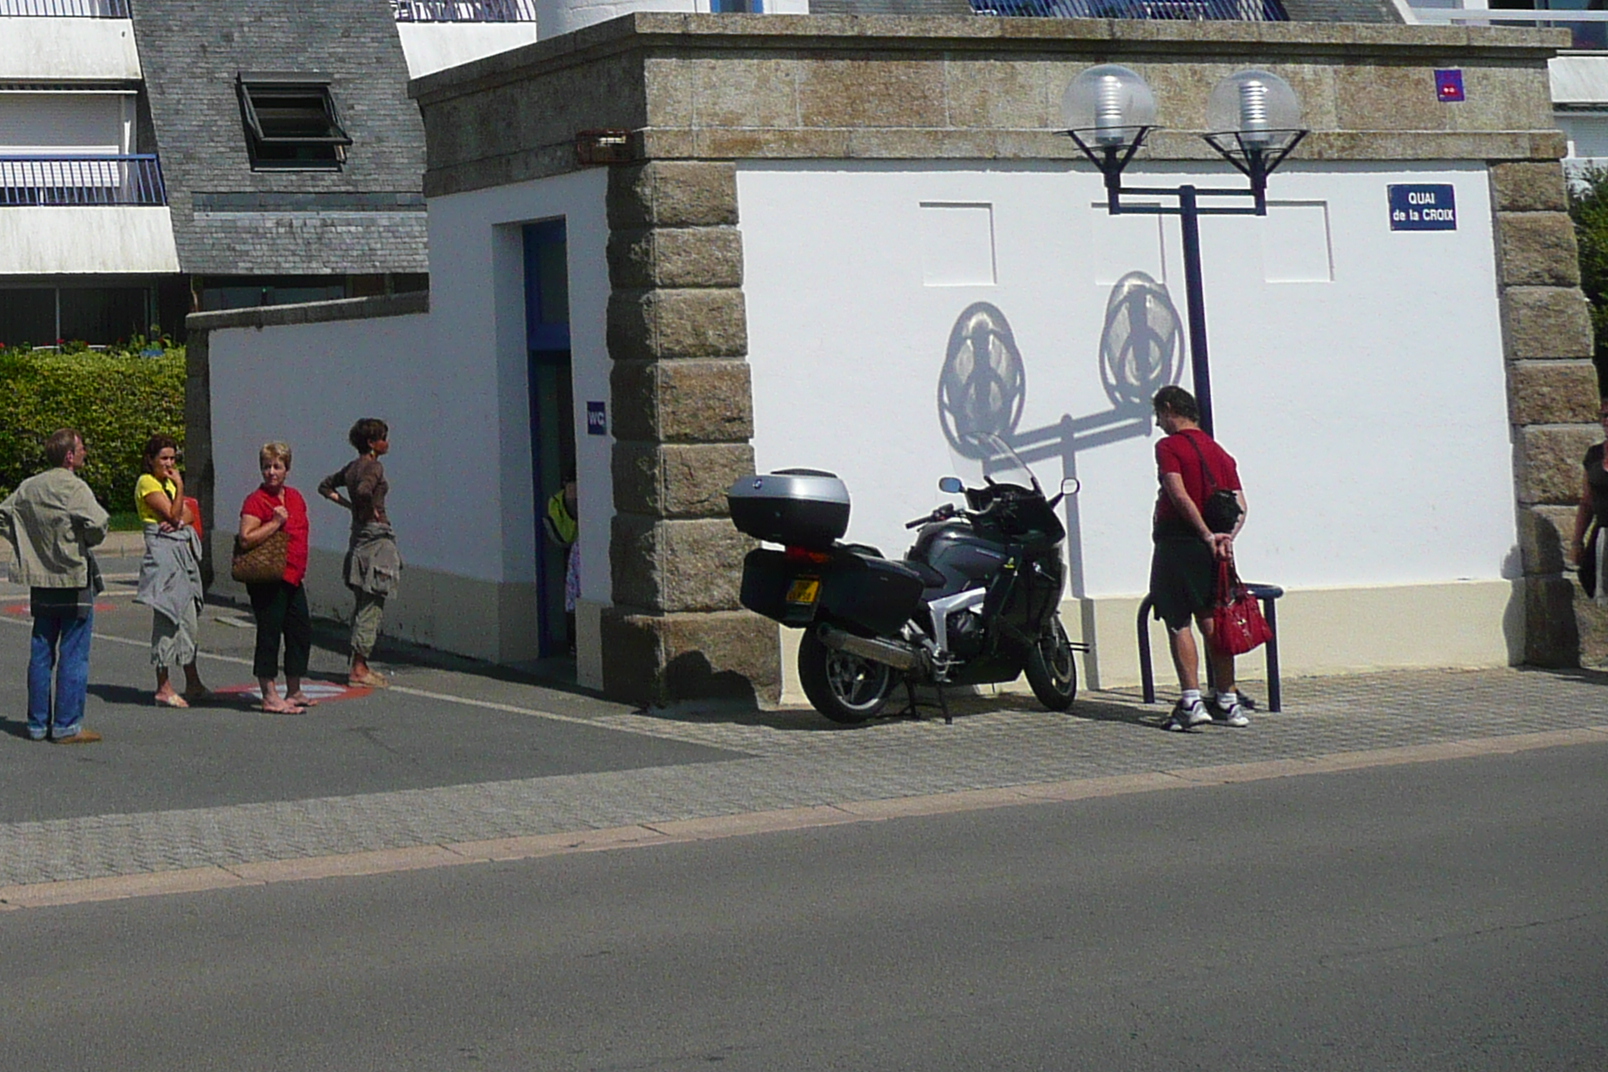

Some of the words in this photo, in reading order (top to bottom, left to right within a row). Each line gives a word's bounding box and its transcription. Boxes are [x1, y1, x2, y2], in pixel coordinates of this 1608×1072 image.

[1408, 192, 1435, 204] QUAI
[1393, 209, 1406, 221] de
[1409, 209, 1420, 221] la
[1422, 209, 1454, 221] CROIX
[588, 411, 605, 425] WC
